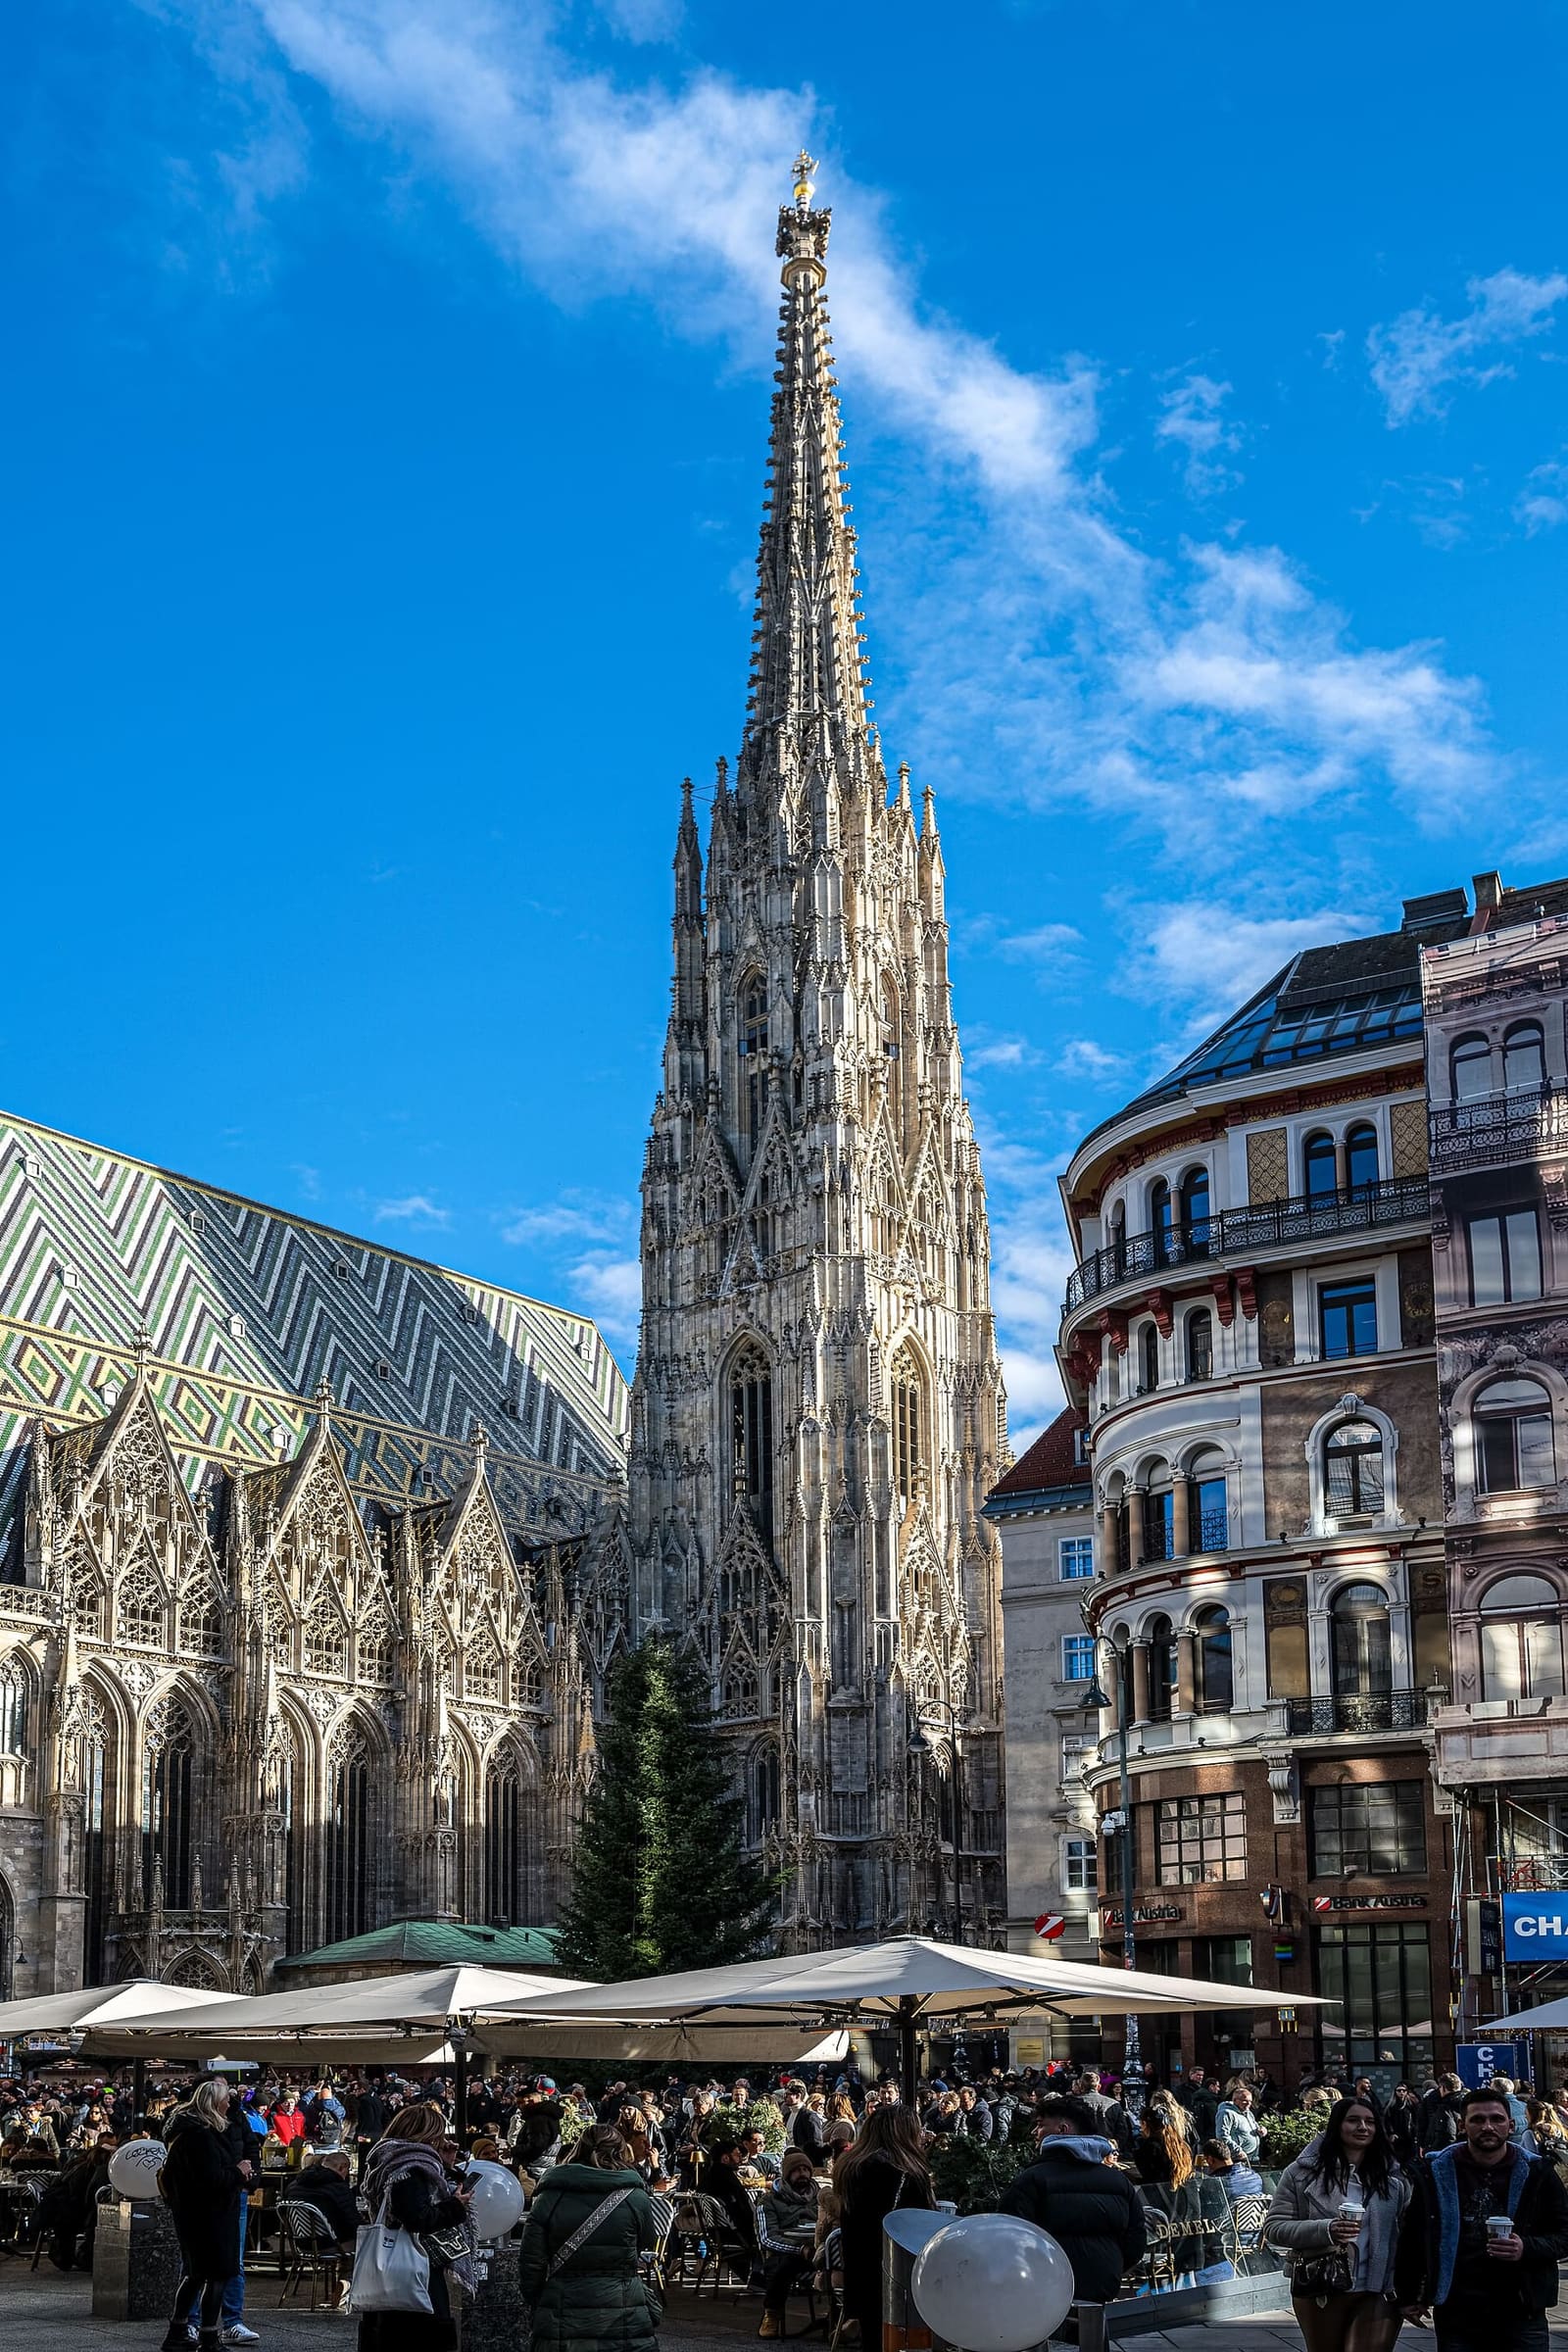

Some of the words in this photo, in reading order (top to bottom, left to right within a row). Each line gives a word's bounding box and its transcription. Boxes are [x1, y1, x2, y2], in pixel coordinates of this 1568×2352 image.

[1332, 1895, 1370, 1909] Bank
[1373, 1894, 1424, 1907] Austria
[1138, 1903, 1179, 1920] Austria
[1156, 2219, 1215, 2238] DEMEL
